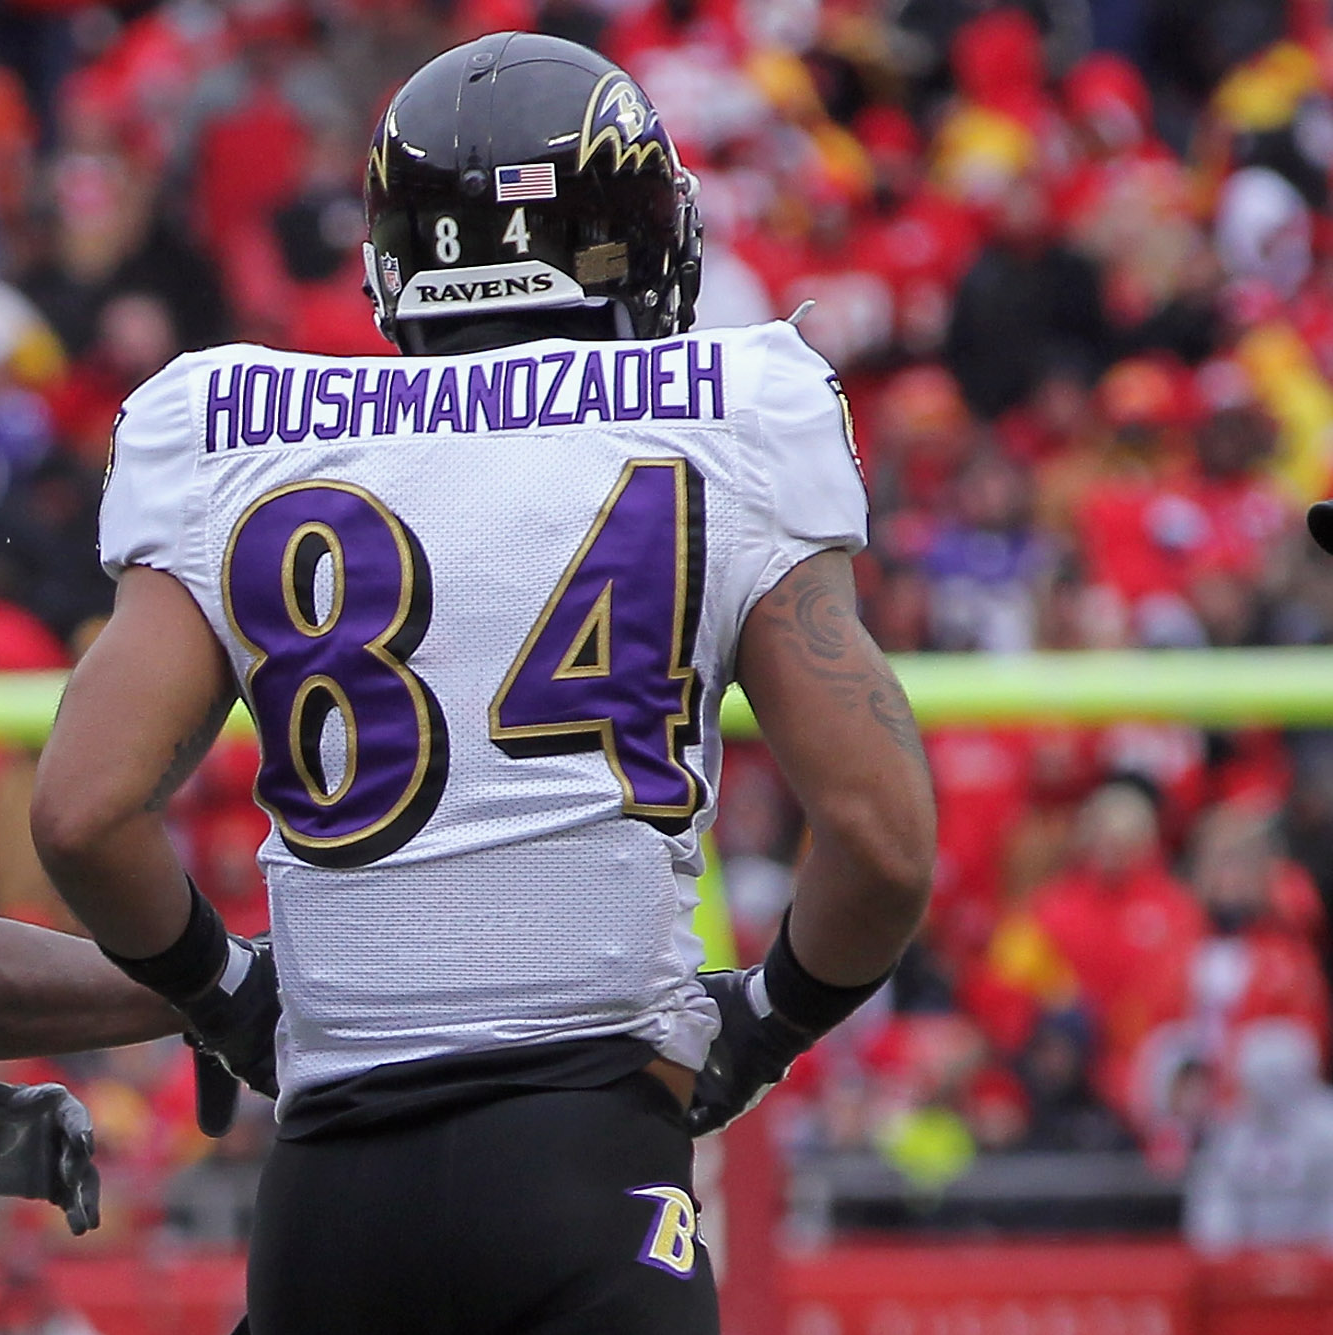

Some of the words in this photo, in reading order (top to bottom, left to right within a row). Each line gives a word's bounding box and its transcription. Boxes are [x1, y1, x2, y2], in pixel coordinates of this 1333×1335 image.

[415, 272, 555, 303] RAVENS
[205, 340, 725, 453] HOUSHMANDZADEH
[220, 456, 707, 869] 84
[622, 1181, 698, 1281] B
